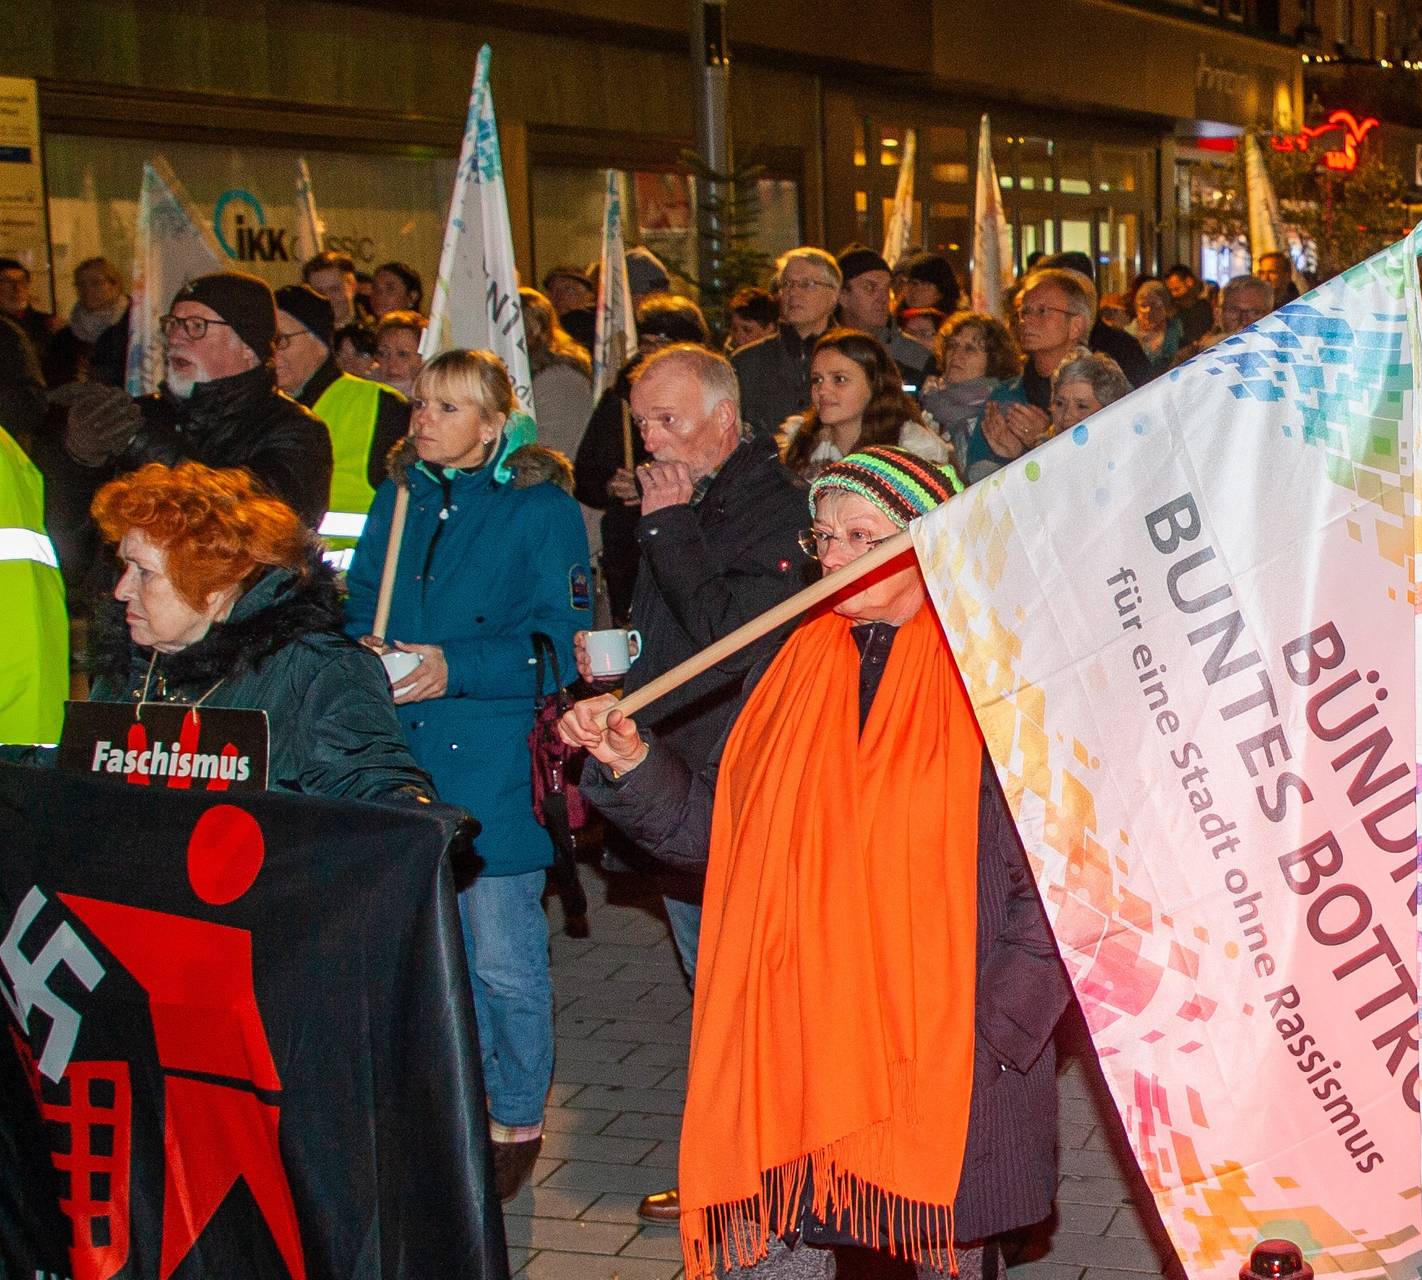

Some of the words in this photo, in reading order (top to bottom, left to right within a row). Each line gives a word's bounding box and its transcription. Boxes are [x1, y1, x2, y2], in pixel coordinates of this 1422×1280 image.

[91, 740, 250, 782] Faschismus
[1106, 567, 1143, 629] für
[1132, 643, 1180, 735] eine
[1170, 742, 1241, 860] Stadt
[1224, 868, 1276, 978] ohne
[1264, 984, 1385, 1174] Rassismus
[1144, 492, 1314, 823] BUNTES
[1278, 829, 1420, 1113] BOTTR
[1282, 620, 1418, 918] BÜND
